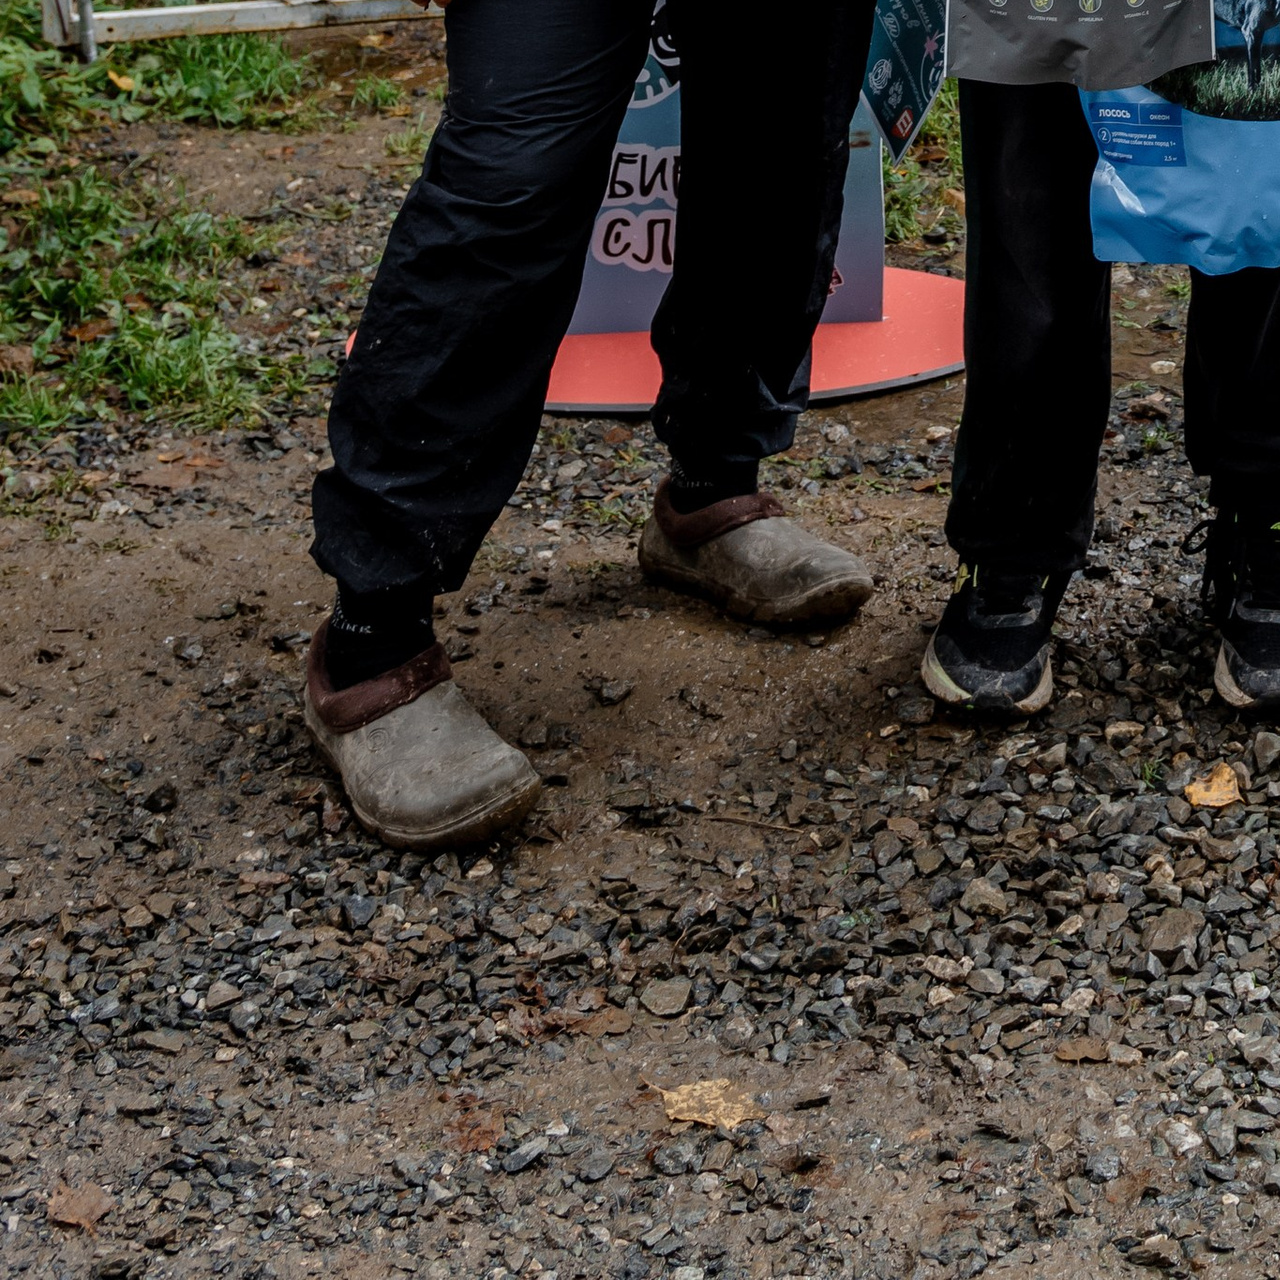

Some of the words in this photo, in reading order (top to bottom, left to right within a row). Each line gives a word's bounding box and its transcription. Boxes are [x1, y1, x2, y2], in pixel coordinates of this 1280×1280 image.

[1098, 109, 1131, 118] ЛОСОСЬ
[1101, 131, 1107, 140] 2
[602, 217, 673, 266] СЛ
